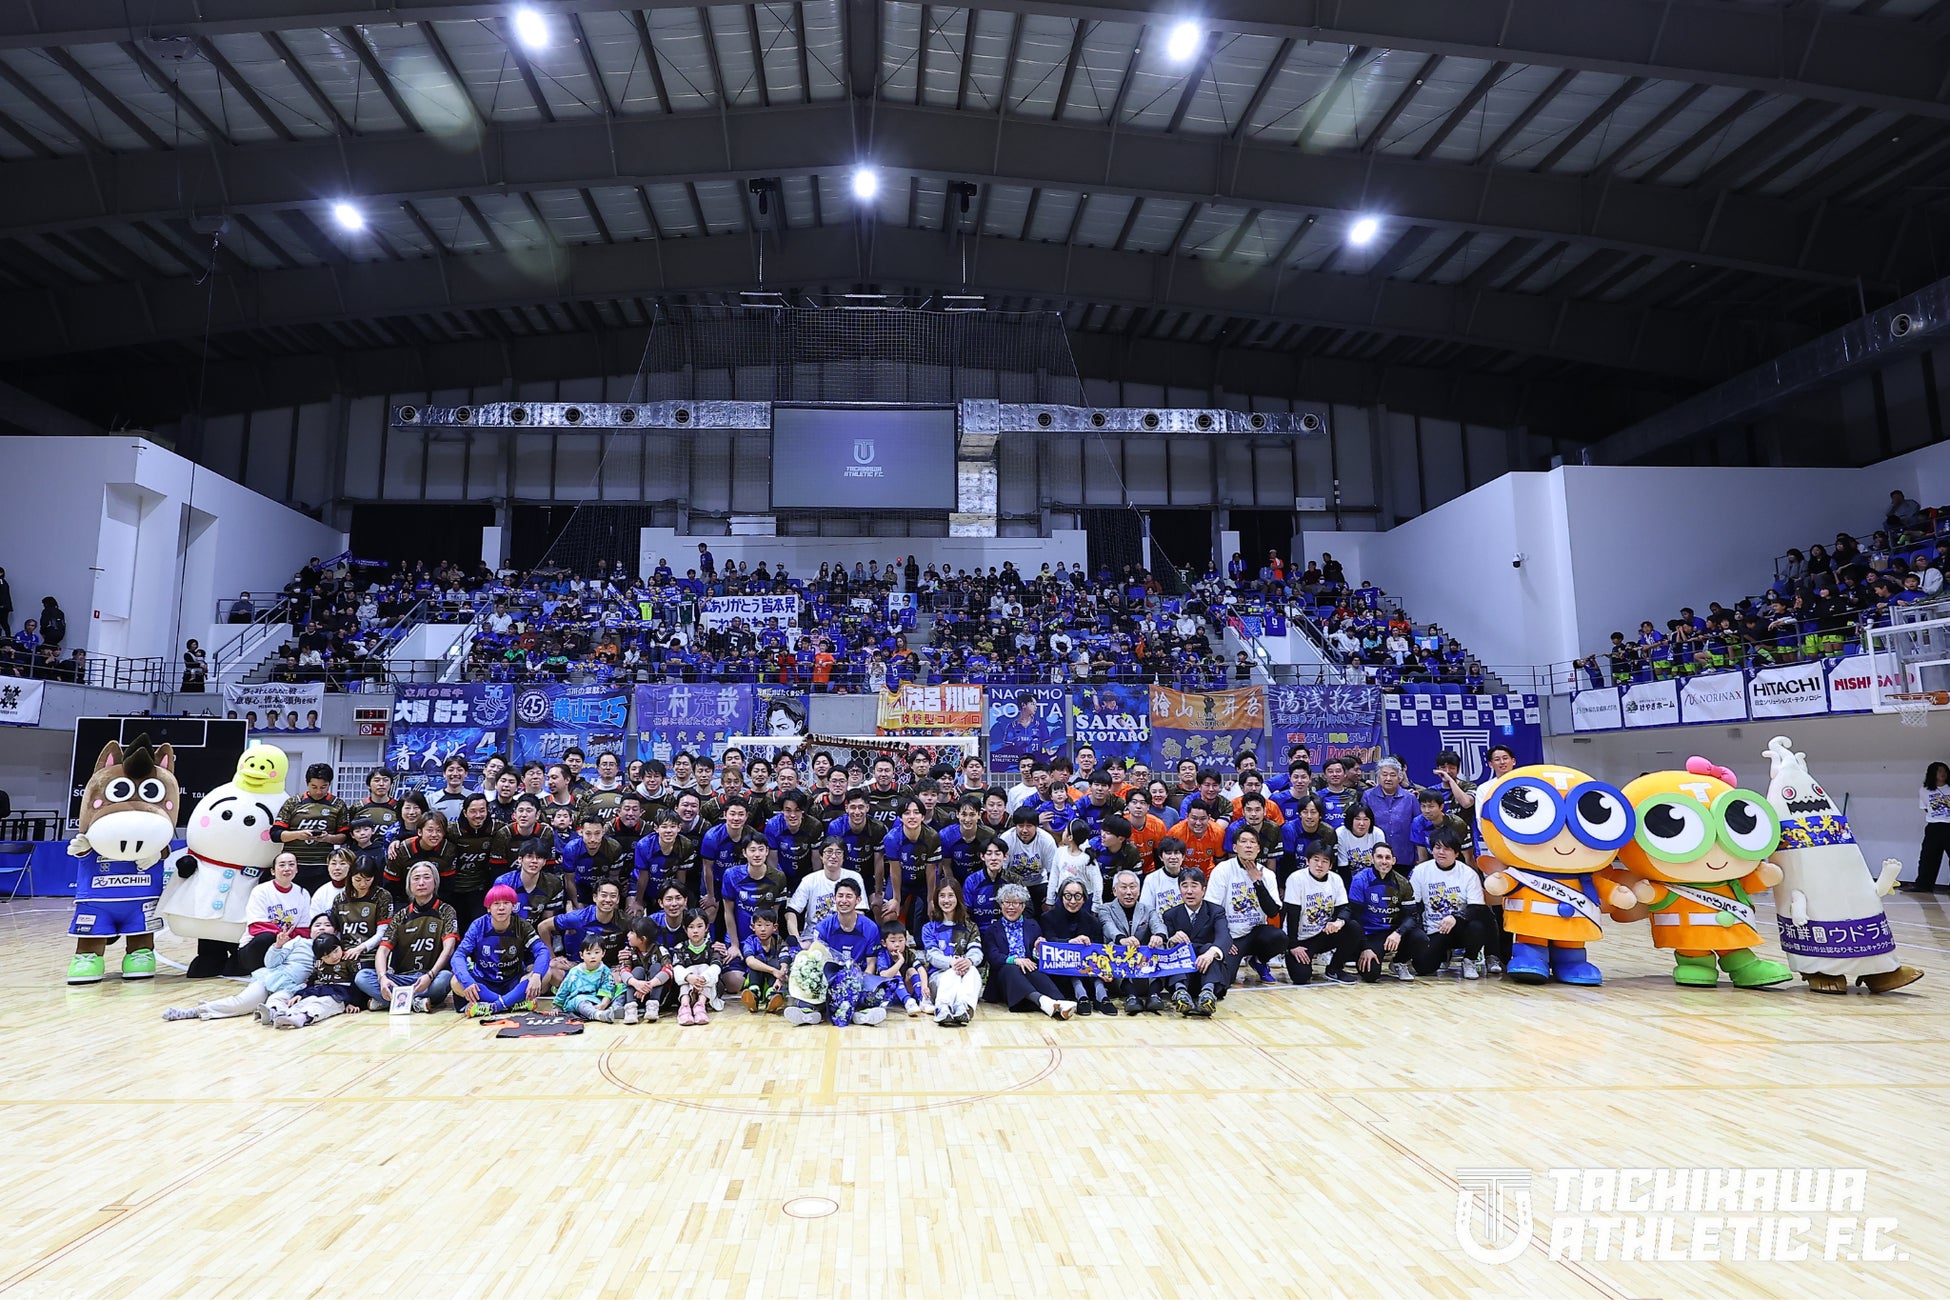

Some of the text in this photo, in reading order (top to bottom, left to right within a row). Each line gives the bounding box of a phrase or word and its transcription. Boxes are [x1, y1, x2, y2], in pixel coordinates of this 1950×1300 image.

[711, 597, 796, 613] ありがとう皆本晃
[484, 685, 504, 700] 56
[1753, 677, 1821, 697] HITACHI
[644, 687, 741, 719] 上村充哉
[1700, 691, 1743, 704] NORINAX
[523, 698, 543, 713] 45
[1639, 701, 1676, 712] けやきホーム
[902, 713, 980, 725] 攻撃型コレイロ
[1076, 714, 1147, 730] SAKAI
[1076, 731, 1148, 742] RYOTARO
[475, 732, 497, 756] 4
[1031, 743, 1039, 751] 21
[874, 811, 897, 821] HIS
[298, 819, 328, 831] HIS
[107, 876, 150, 886] TACHIHI
[343, 922, 369, 934] HIS
[1042, 944, 1081, 962] AKIRA
[414, 955, 424, 970] 5
[1043, 961, 1082, 969] MINAMOTO
